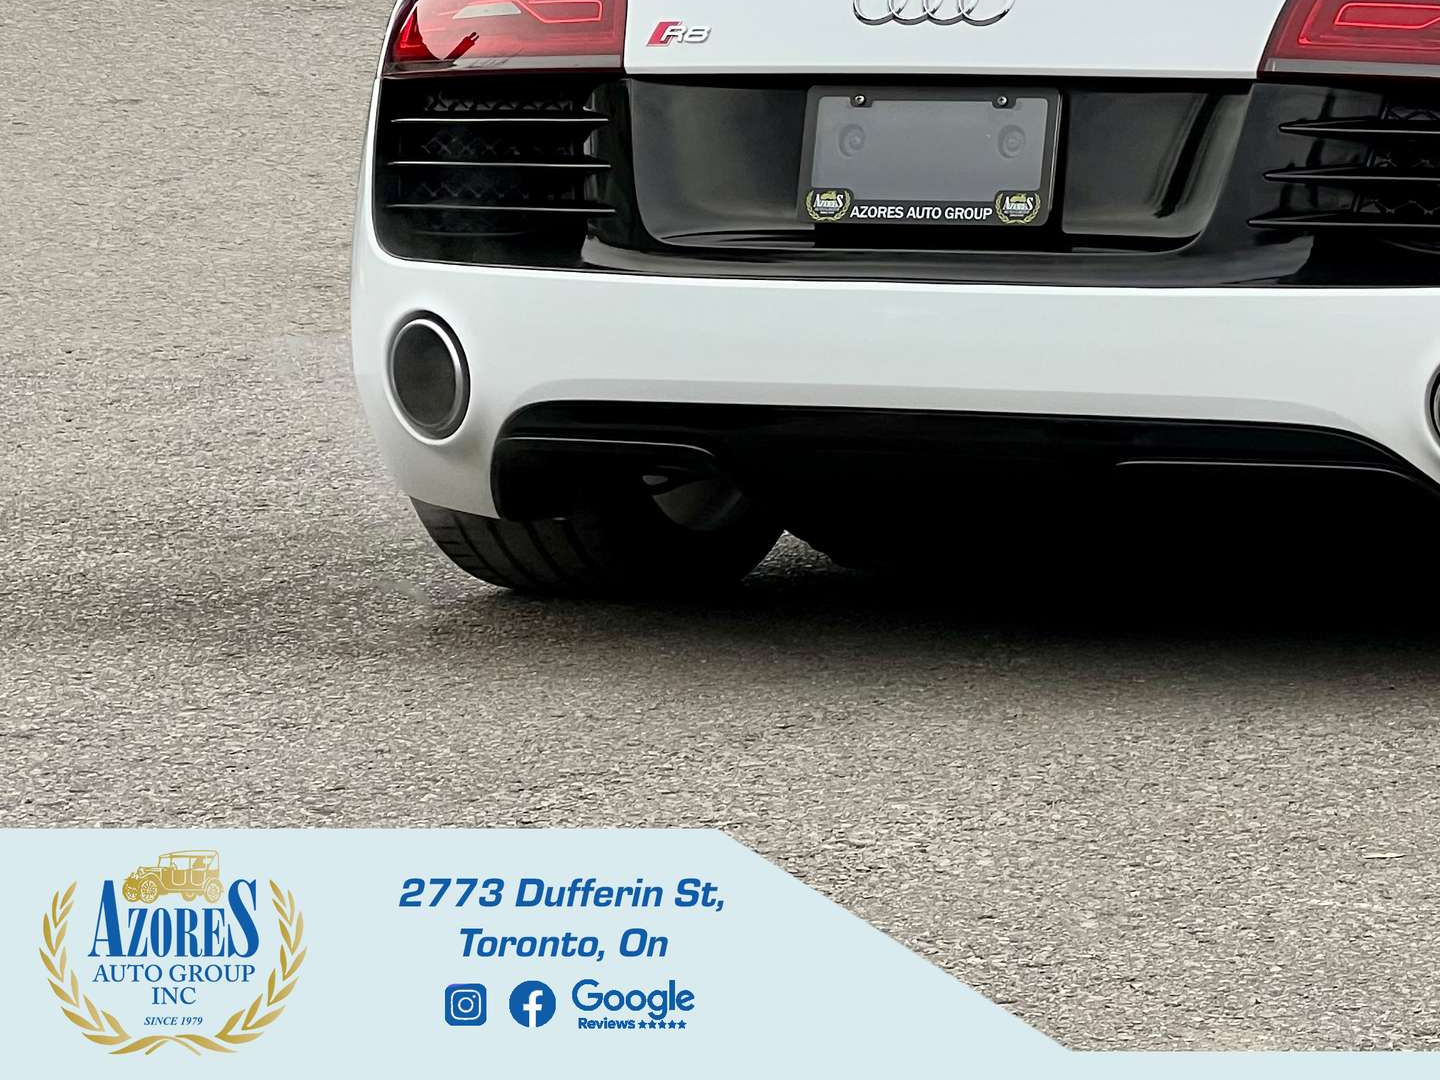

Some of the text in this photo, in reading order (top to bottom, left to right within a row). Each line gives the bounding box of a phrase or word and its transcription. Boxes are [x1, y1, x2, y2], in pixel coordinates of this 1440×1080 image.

[653, 21, 712, 45] R8
[849, 205, 904, 219] AZORES
[905, 206, 941, 219] AUTO
[944, 207, 993, 220] GROUP
